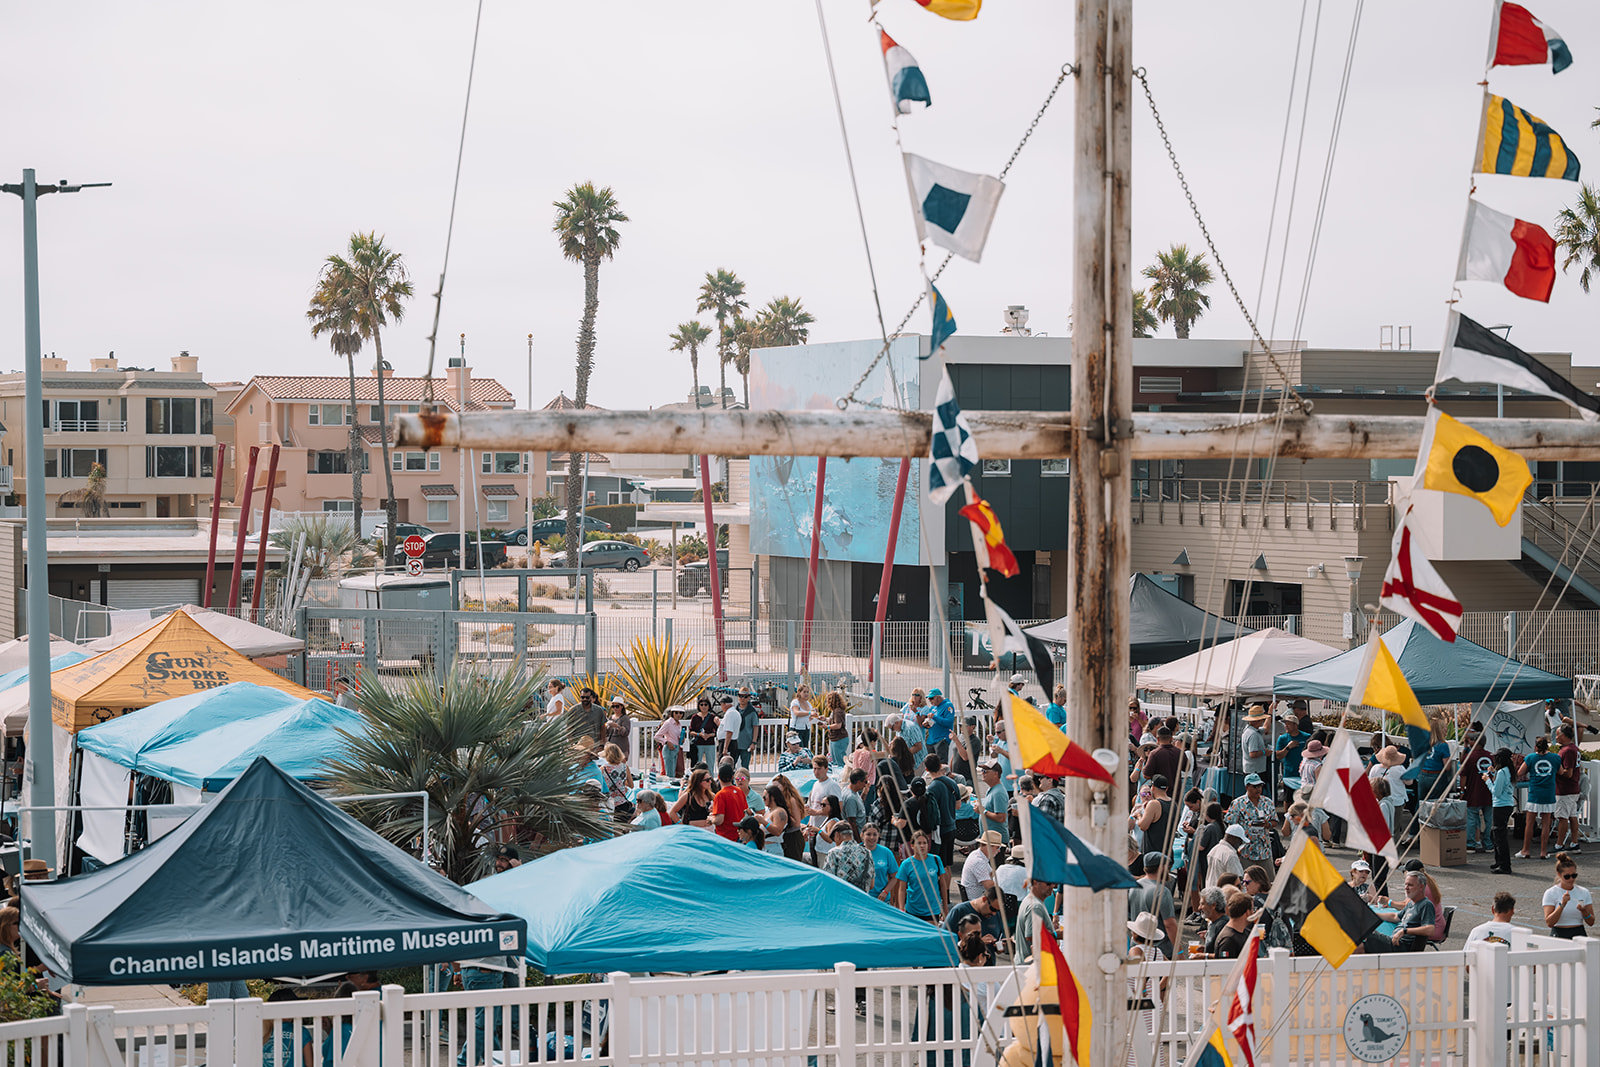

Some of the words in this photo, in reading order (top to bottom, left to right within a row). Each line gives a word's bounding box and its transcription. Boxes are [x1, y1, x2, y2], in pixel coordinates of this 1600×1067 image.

[405, 541, 425, 551] STOP
[145, 651, 205, 669] GUN
[145, 663, 230, 681] SMOKE
[109, 950, 205, 976] Channel
[211, 942, 293, 967] Islands
[299, 934, 396, 960] Maritime
[402, 927, 494, 951] Museum
[1349, 1037, 1384, 1060] LEARNING
[1386, 1036, 1402, 1055] CLUB
